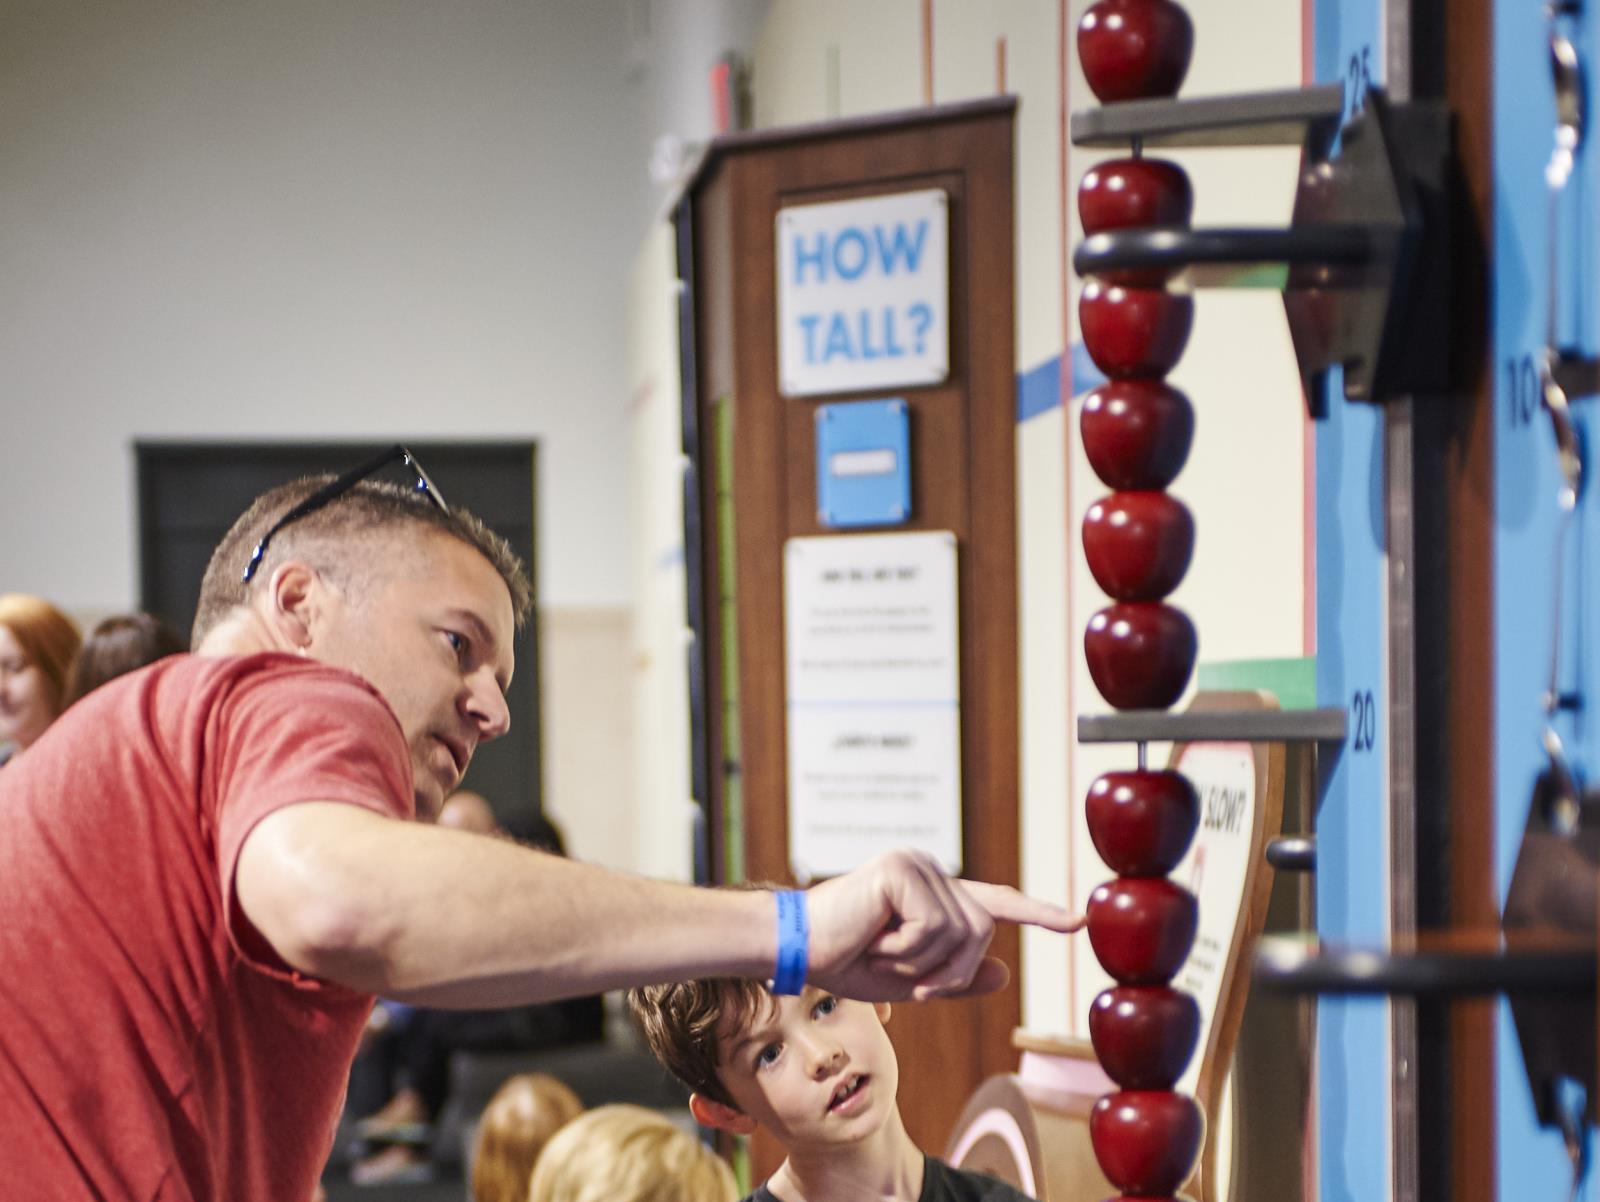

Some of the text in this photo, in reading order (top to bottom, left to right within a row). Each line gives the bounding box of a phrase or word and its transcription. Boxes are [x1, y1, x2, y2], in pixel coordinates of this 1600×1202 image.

[793, 217, 929, 287] HOW
[797, 302, 933, 366] TALL?
[1508, 354, 1537, 429] 10
[1353, 688, 1376, 753] 20
[1204, 785, 1247, 836] SLOW?
